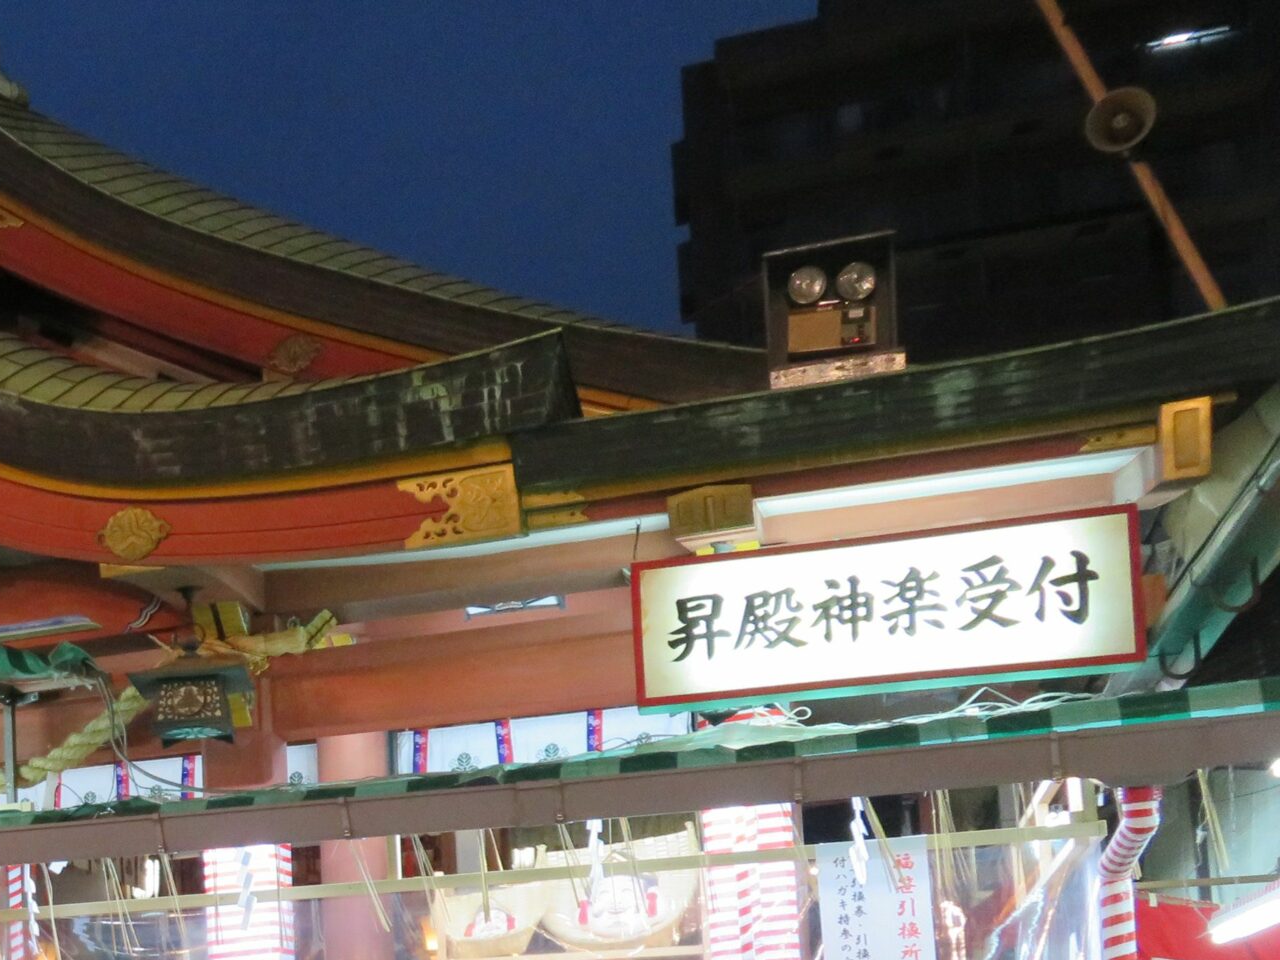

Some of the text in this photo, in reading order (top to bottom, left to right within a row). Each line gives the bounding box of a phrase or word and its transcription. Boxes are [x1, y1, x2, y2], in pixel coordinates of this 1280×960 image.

[667, 550, 1100, 663] 昇殿神楽受付
